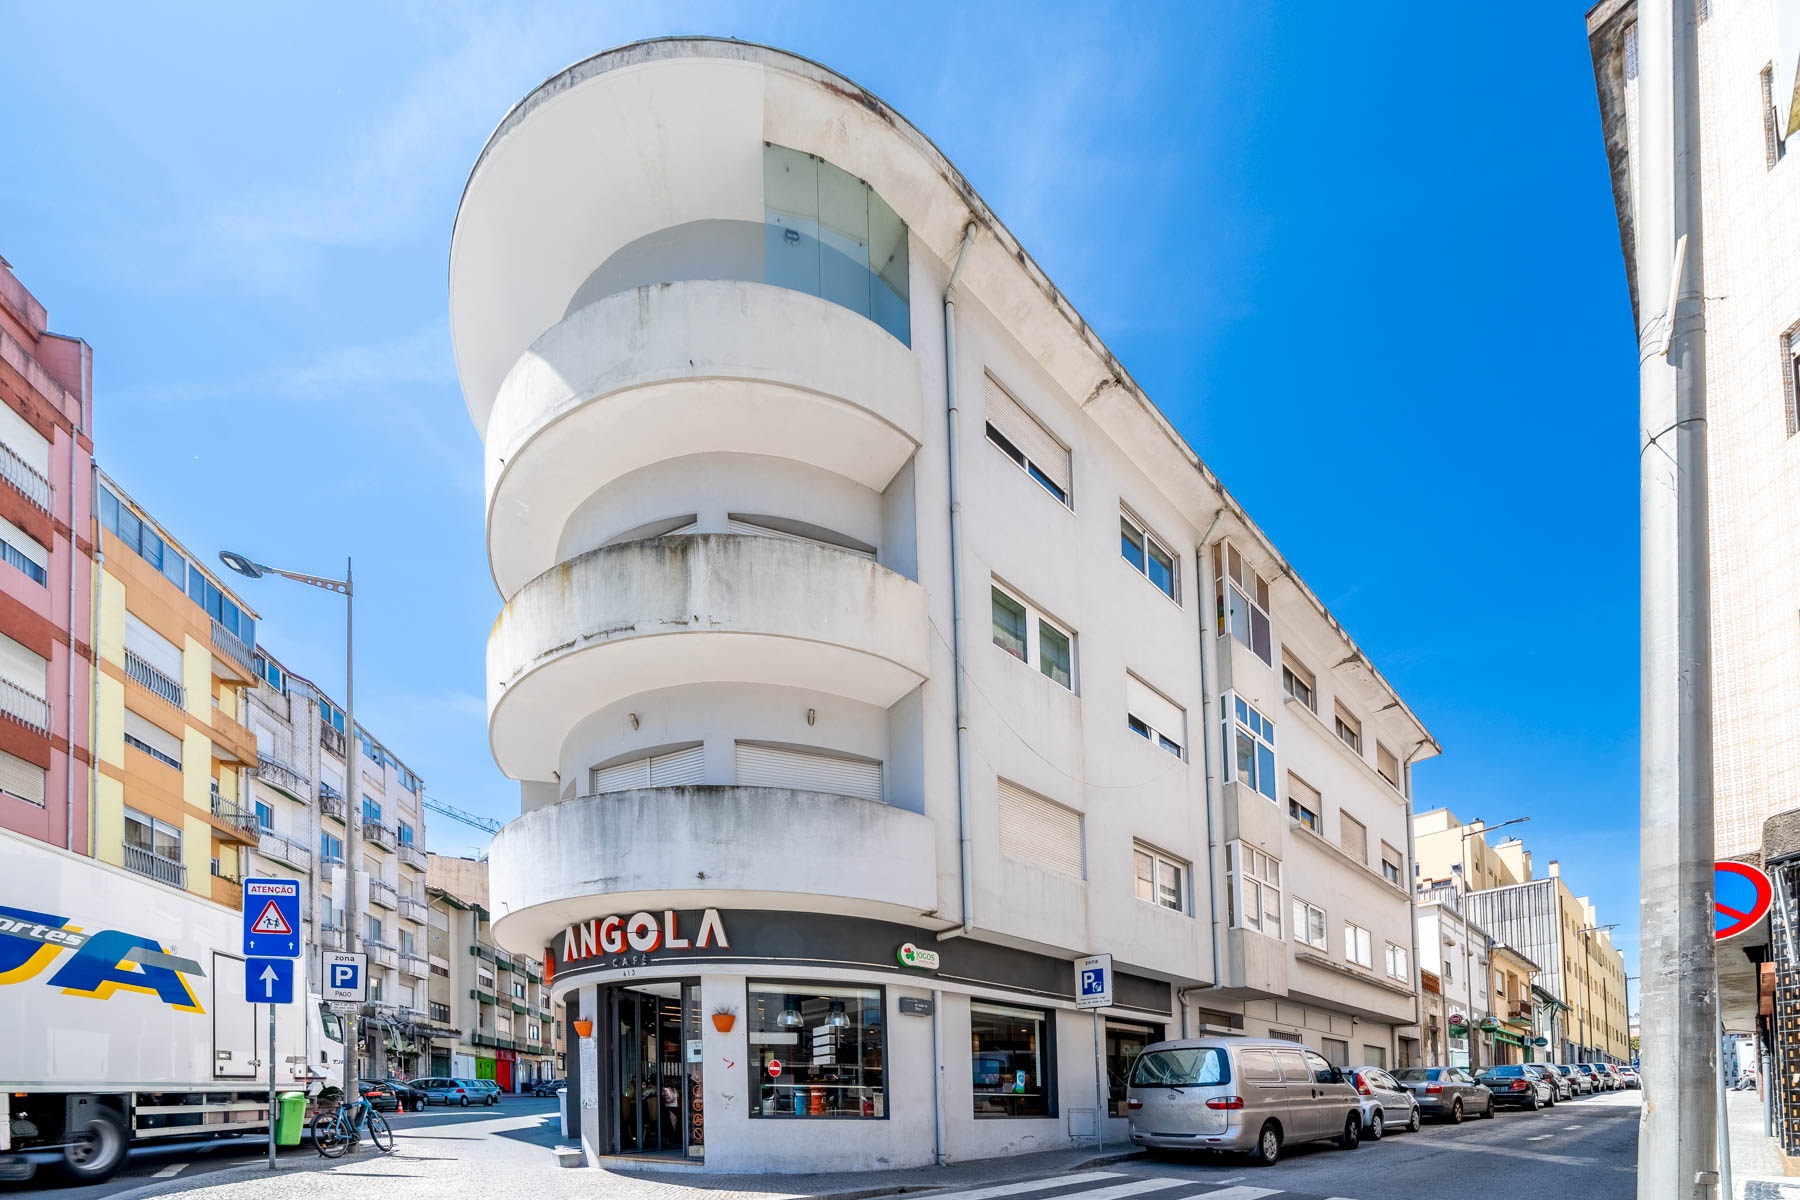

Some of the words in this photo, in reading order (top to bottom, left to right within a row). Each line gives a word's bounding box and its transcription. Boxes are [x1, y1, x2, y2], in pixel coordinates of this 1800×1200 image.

[251, 885, 294, 895] ATENÇÃO
[562, 907, 730, 962] ANGOLA
[612, 953, 647, 968] CAFÉ
[916, 951, 935, 961] JOGOS
[335, 966, 353, 987] P
[1083, 971, 1095, 989] P
[334, 990, 352, 998] PAGO
